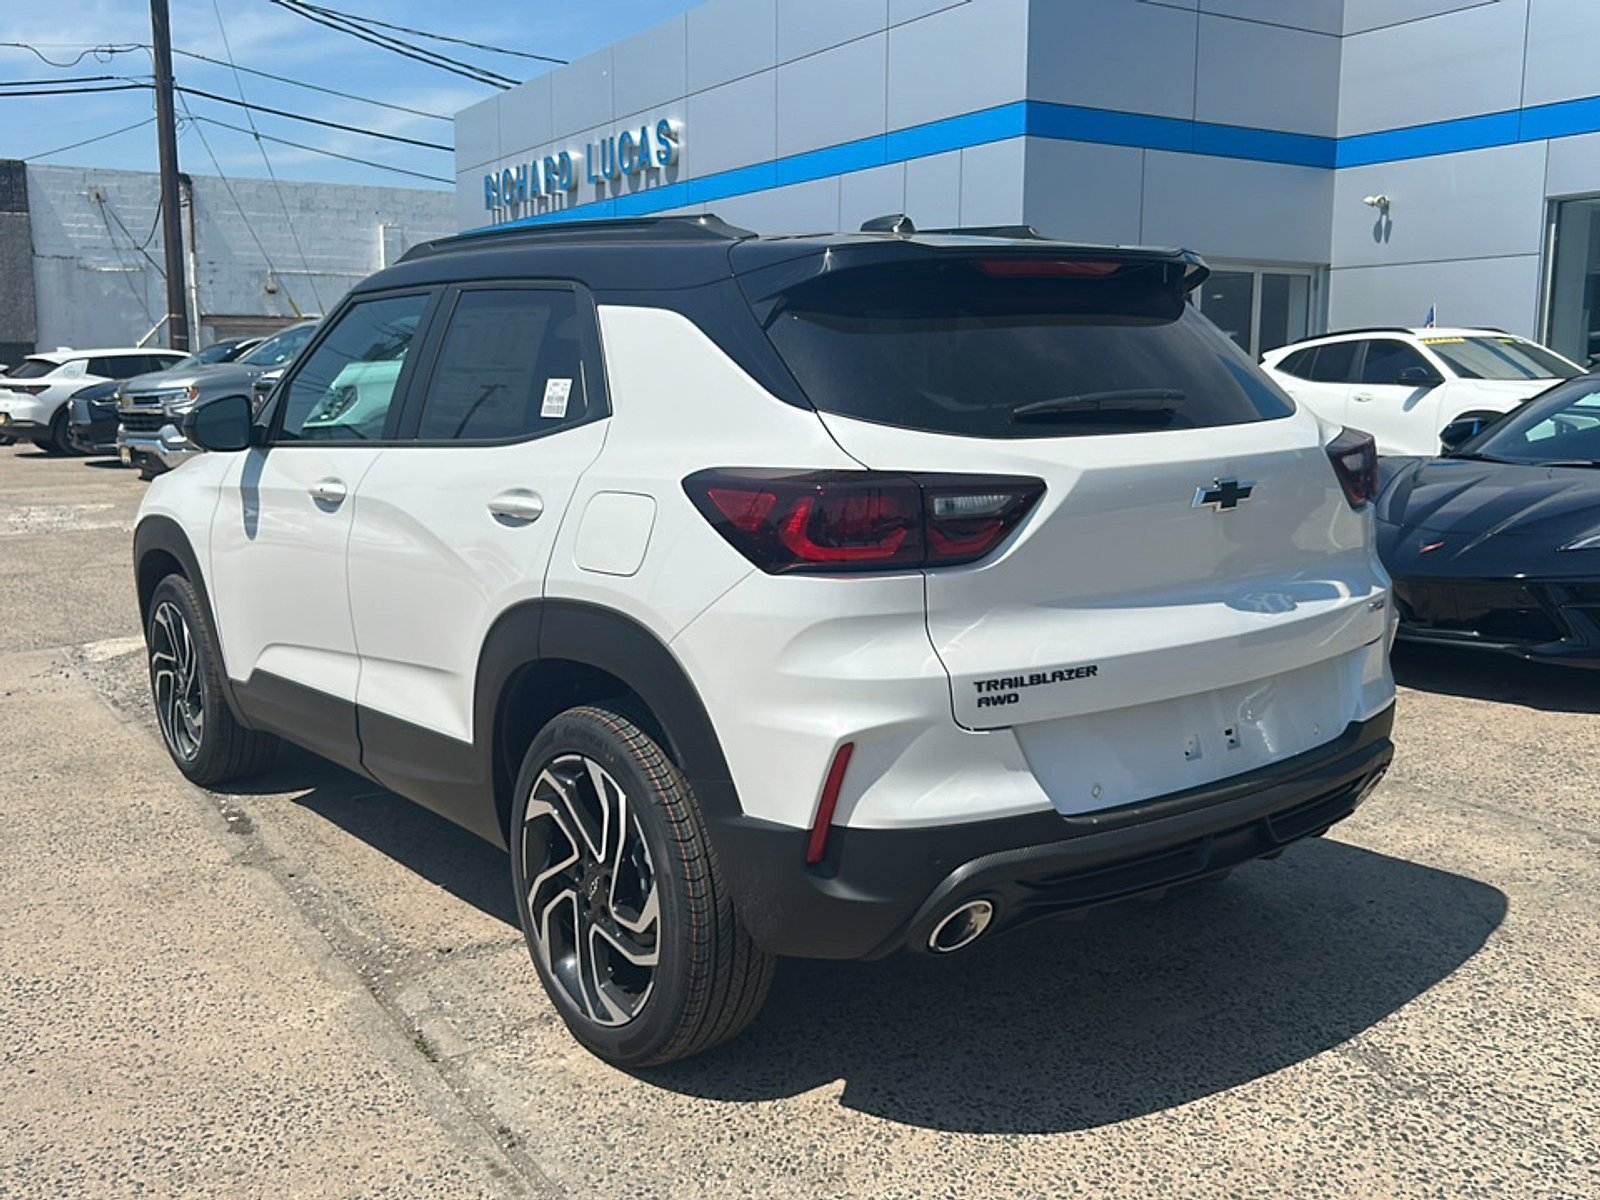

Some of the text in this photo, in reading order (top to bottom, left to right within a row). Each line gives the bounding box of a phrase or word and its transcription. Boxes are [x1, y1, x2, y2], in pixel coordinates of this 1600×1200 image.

[485, 119, 674, 210] RICHARD LUCAS
[973, 665, 1098, 692] TRAILBLAZER
[977, 693, 1020, 708] AWD
